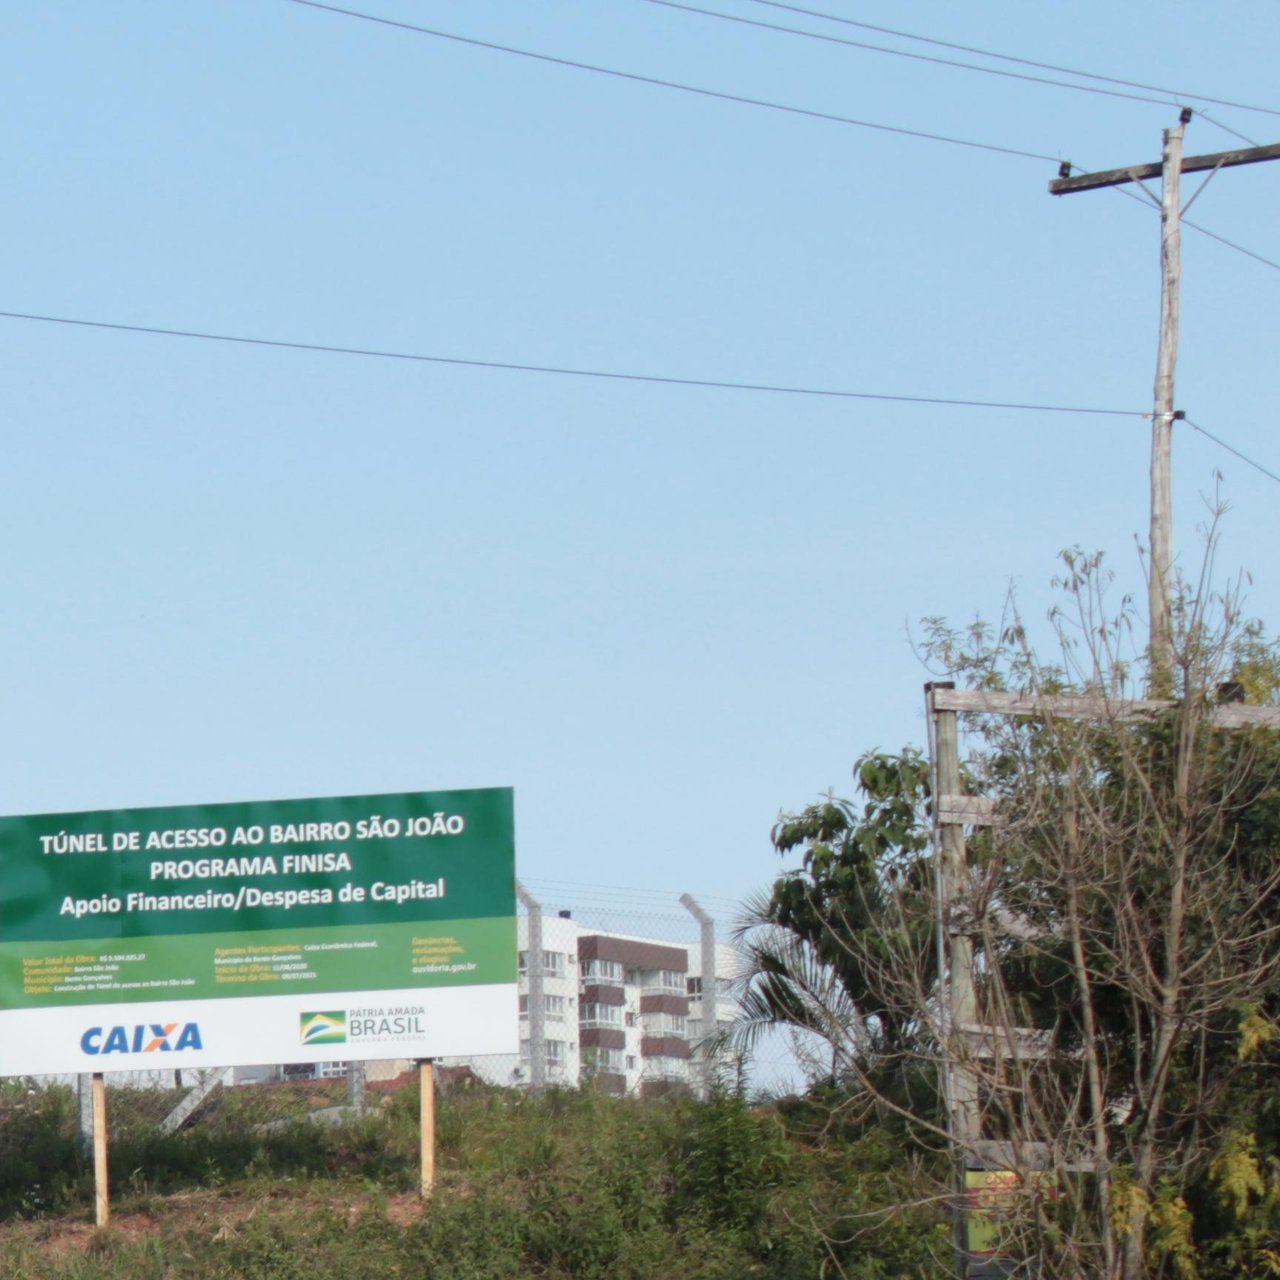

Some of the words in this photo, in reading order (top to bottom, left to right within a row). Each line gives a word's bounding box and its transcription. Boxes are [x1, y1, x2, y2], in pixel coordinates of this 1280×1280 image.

[40, 831, 108, 854] TÚNEL
[112, 832, 140, 851] DE
[146, 828, 226, 849] ACESSO
[231, 826, 264, 846] AO
[269, 822, 351, 844] BAIRRO
[356, 815, 400, 839] SÃO
[405, 812, 464, 837] JOÃO
[150, 857, 277, 880] PROGRAMA
[282, 853, 352, 874] FINISA
[59, 893, 121, 918] Apoio
[127, 886, 333, 912] Financeiro/Despesa
[338, 883, 365, 902] de
[370, 878, 445, 904] Capital
[412, 962, 477, 973] ouvidoria.gov.br
[387, 1006, 425, 1016] AMADA
[80, 1022, 203, 1055] CAIXA
[350, 1016, 426, 1037] BRASIL
